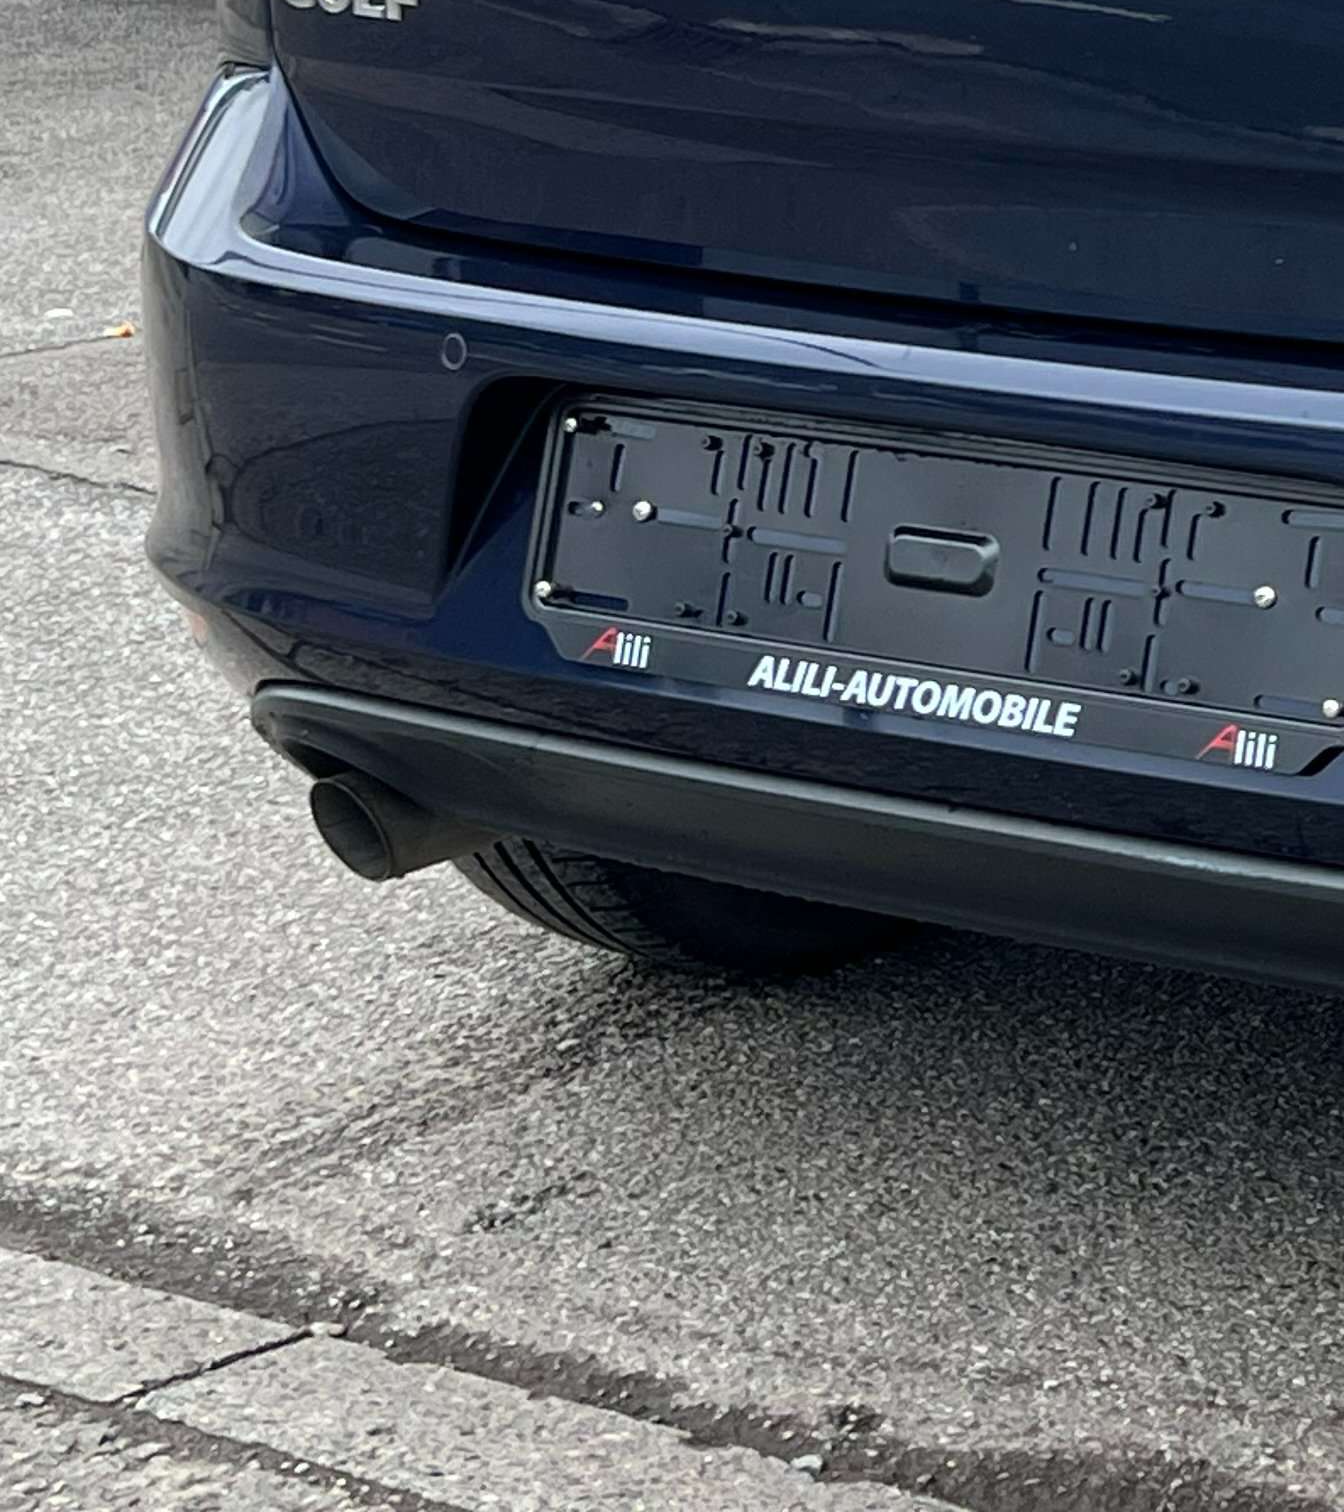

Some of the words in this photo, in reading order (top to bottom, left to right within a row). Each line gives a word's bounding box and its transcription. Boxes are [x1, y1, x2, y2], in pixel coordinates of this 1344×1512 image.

[582, 626, 652, 668] Alili
[748, 654, 1083, 738] ALILI-AUTOMOBILE
[1196, 724, 1278, 770] Alili
